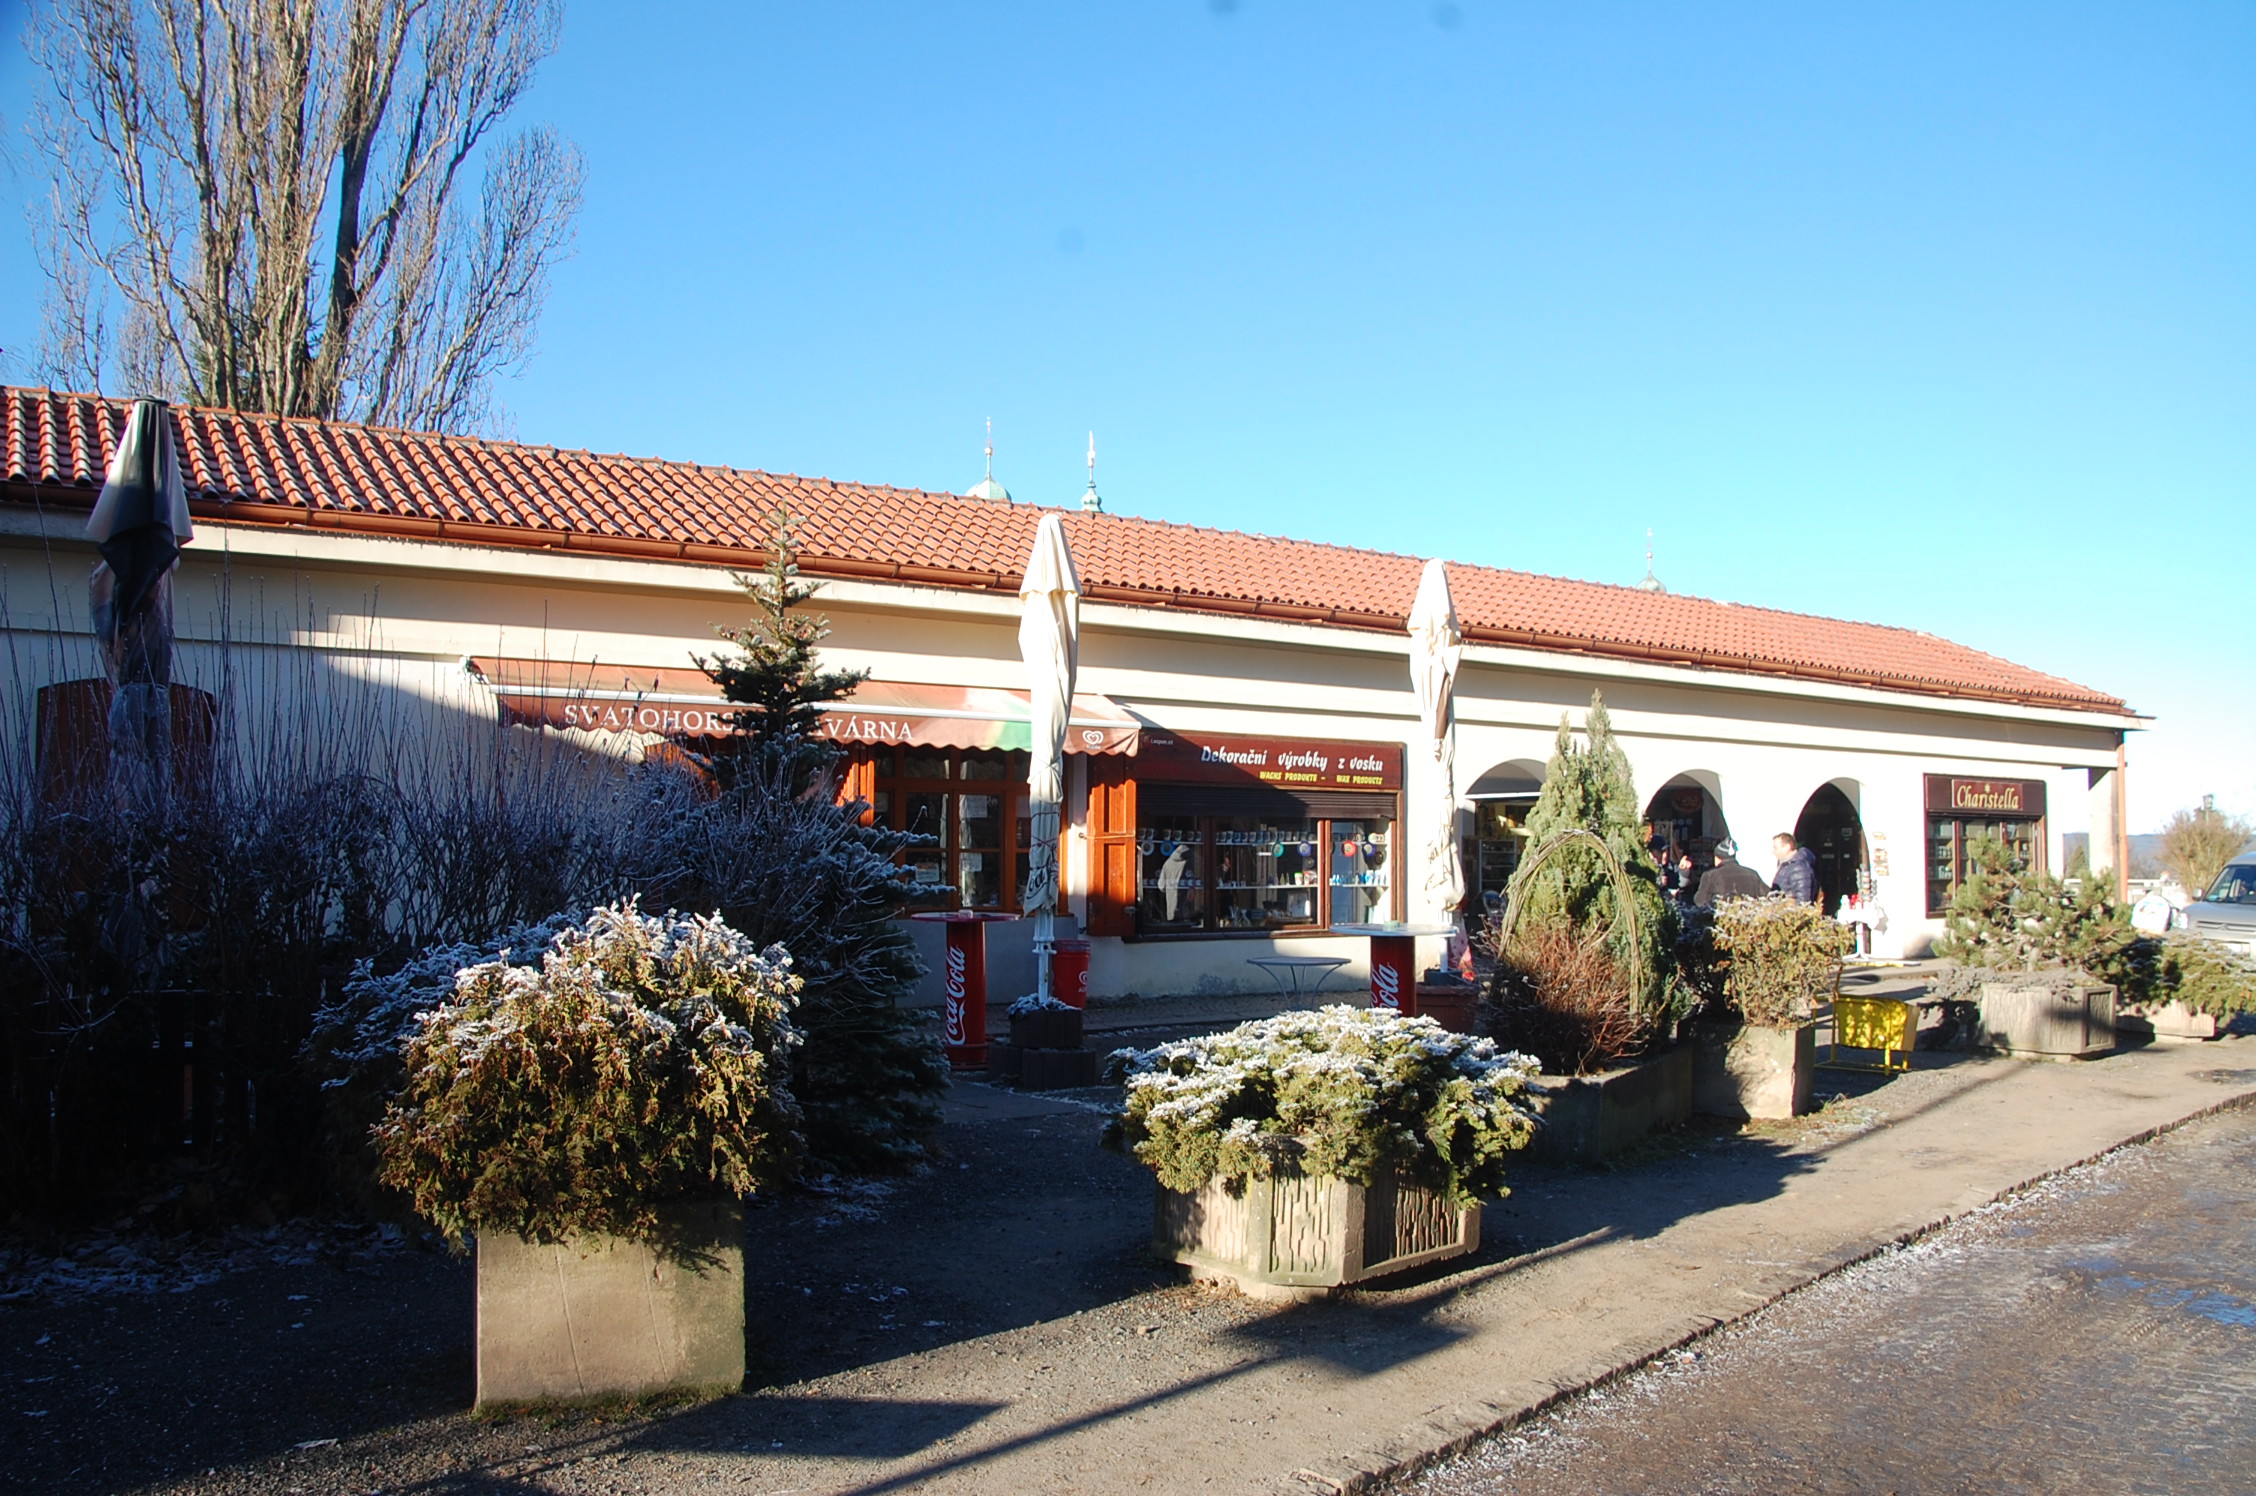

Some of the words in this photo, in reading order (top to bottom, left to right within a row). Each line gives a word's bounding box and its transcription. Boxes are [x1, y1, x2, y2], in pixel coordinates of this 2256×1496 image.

[564, 704, 734, 732] SVATOHORS
[806, 715, 914, 740] VÁRNA
[1201, 745, 1268, 766] Dekorační
[1277, 750, 1328, 772] výrobky
[1337, 757, 1346, 769] z
[1349, 754, 1383, 771] vosku
[1956, 784, 2019, 809] Charistella
